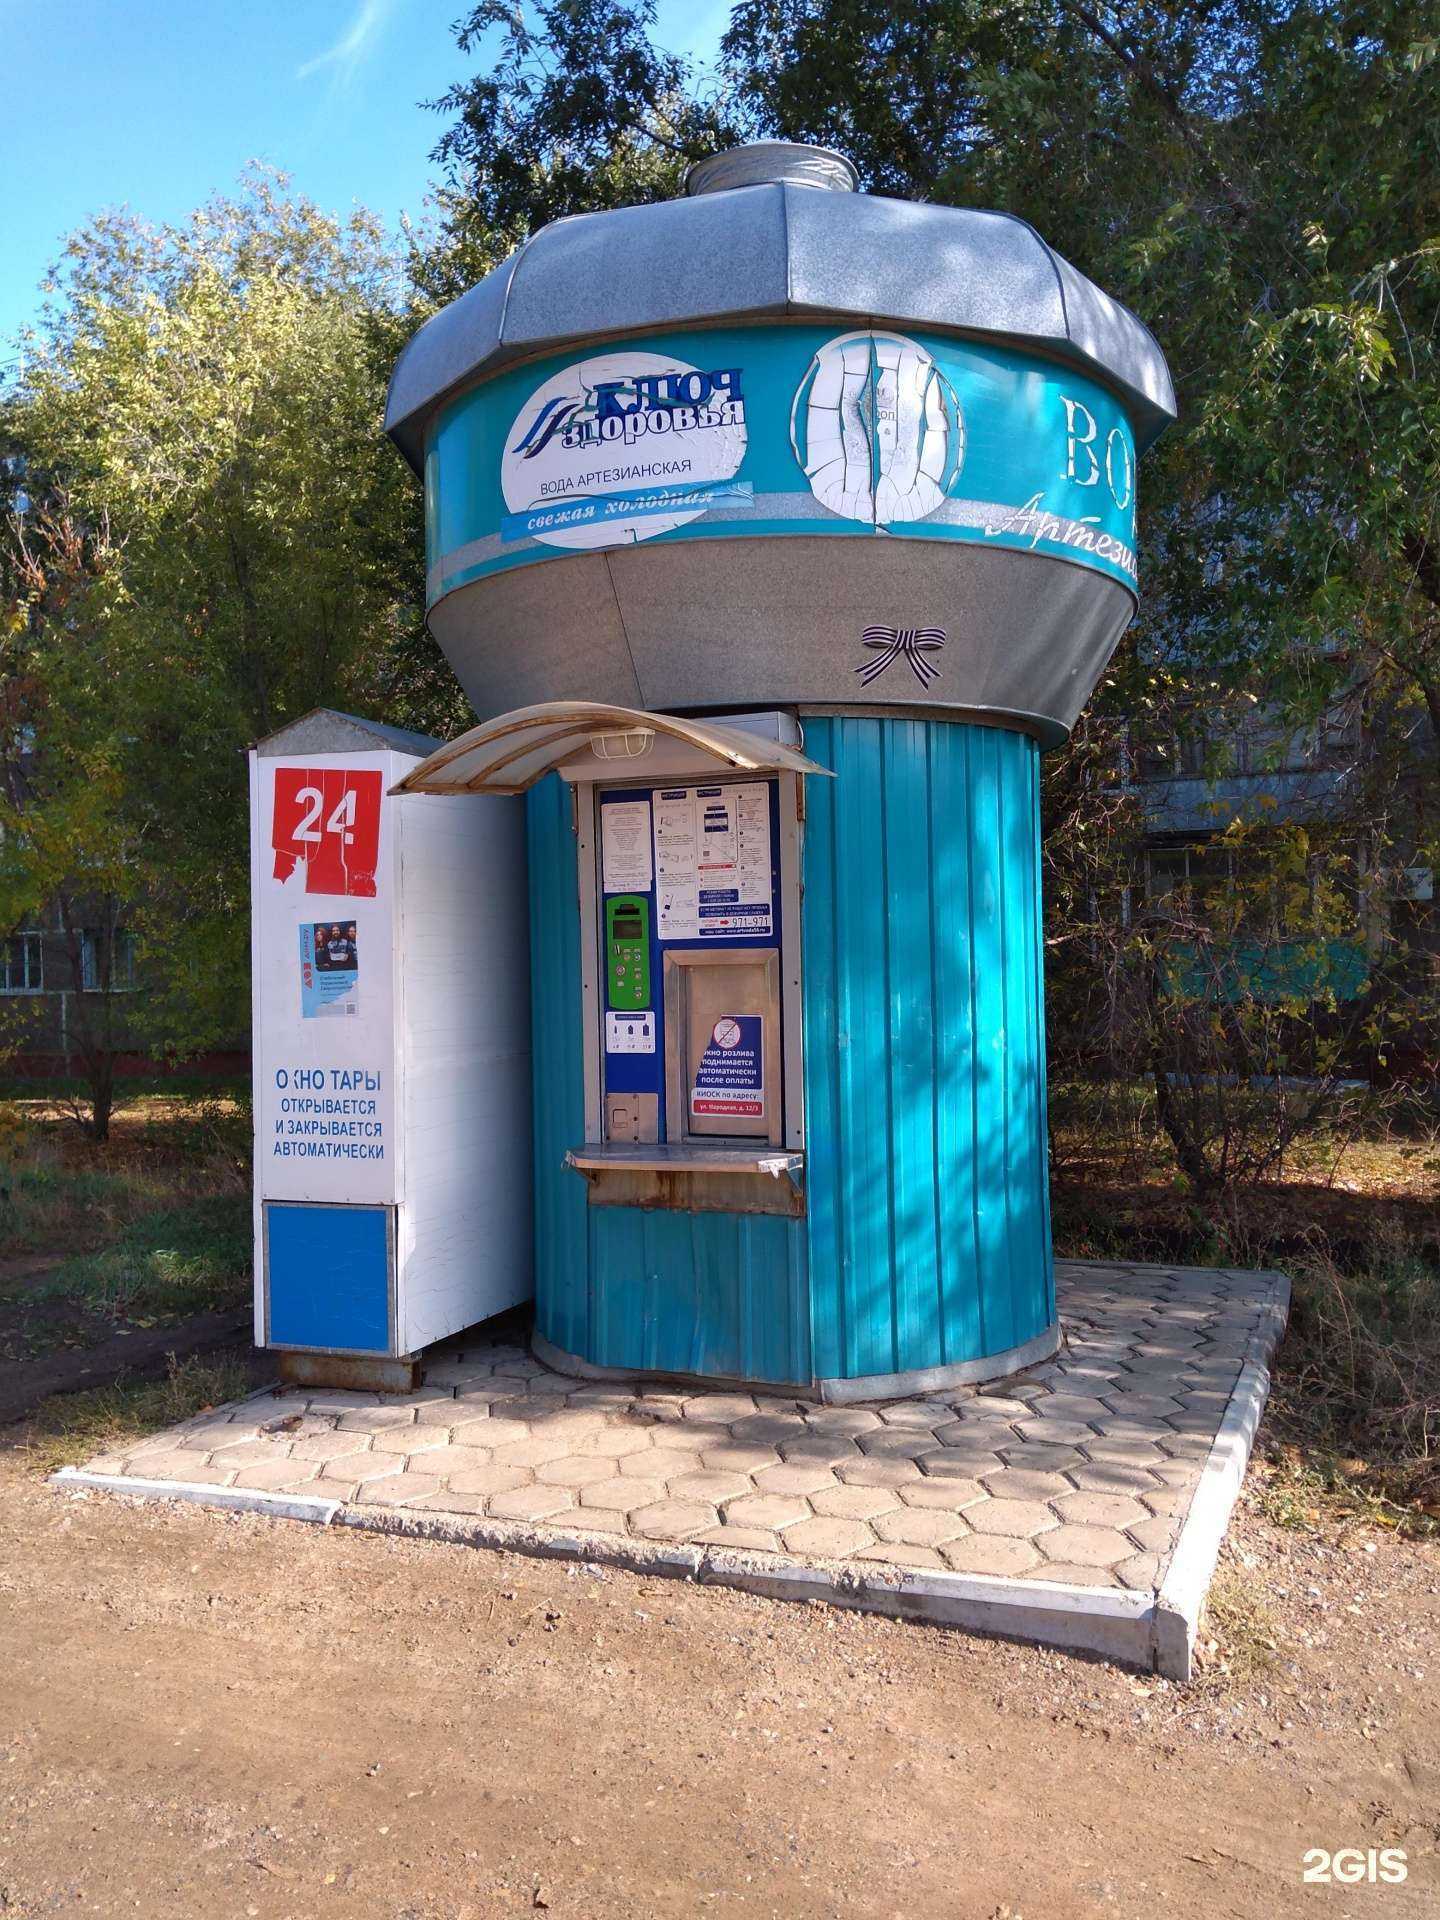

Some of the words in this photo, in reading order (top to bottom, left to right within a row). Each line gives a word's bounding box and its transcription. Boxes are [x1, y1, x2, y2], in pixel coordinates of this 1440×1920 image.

[1059, 394, 1138, 525] ВО
[540, 476, 575, 495] ВОДА
[577, 459, 692, 488] АРТЕЗИАНСКАЯ
[527, 503, 596, 530] свежая
[292, 787, 357, 845] 24
[732, 917, 768, 928] 971-971
[702, 1058, 753, 1067] поднимается
[722, 1050, 755, 1058] розлива
[698, 1067, 757, 1075] автоматически
[330, 1070, 381, 1091] ТАРЫ
[701, 1076, 724, 1084] после
[725, 1077, 754, 1085] оплаты
[281, 1098, 376, 1115] ОТКРЫВАЕТСЯ
[275, 1119, 284, 1134] И
[287, 1120, 382, 1137] ЗАКРЫВАЕТСЯ
[273, 1141, 384, 1159] АВТОМАТИЧЕСКИ
